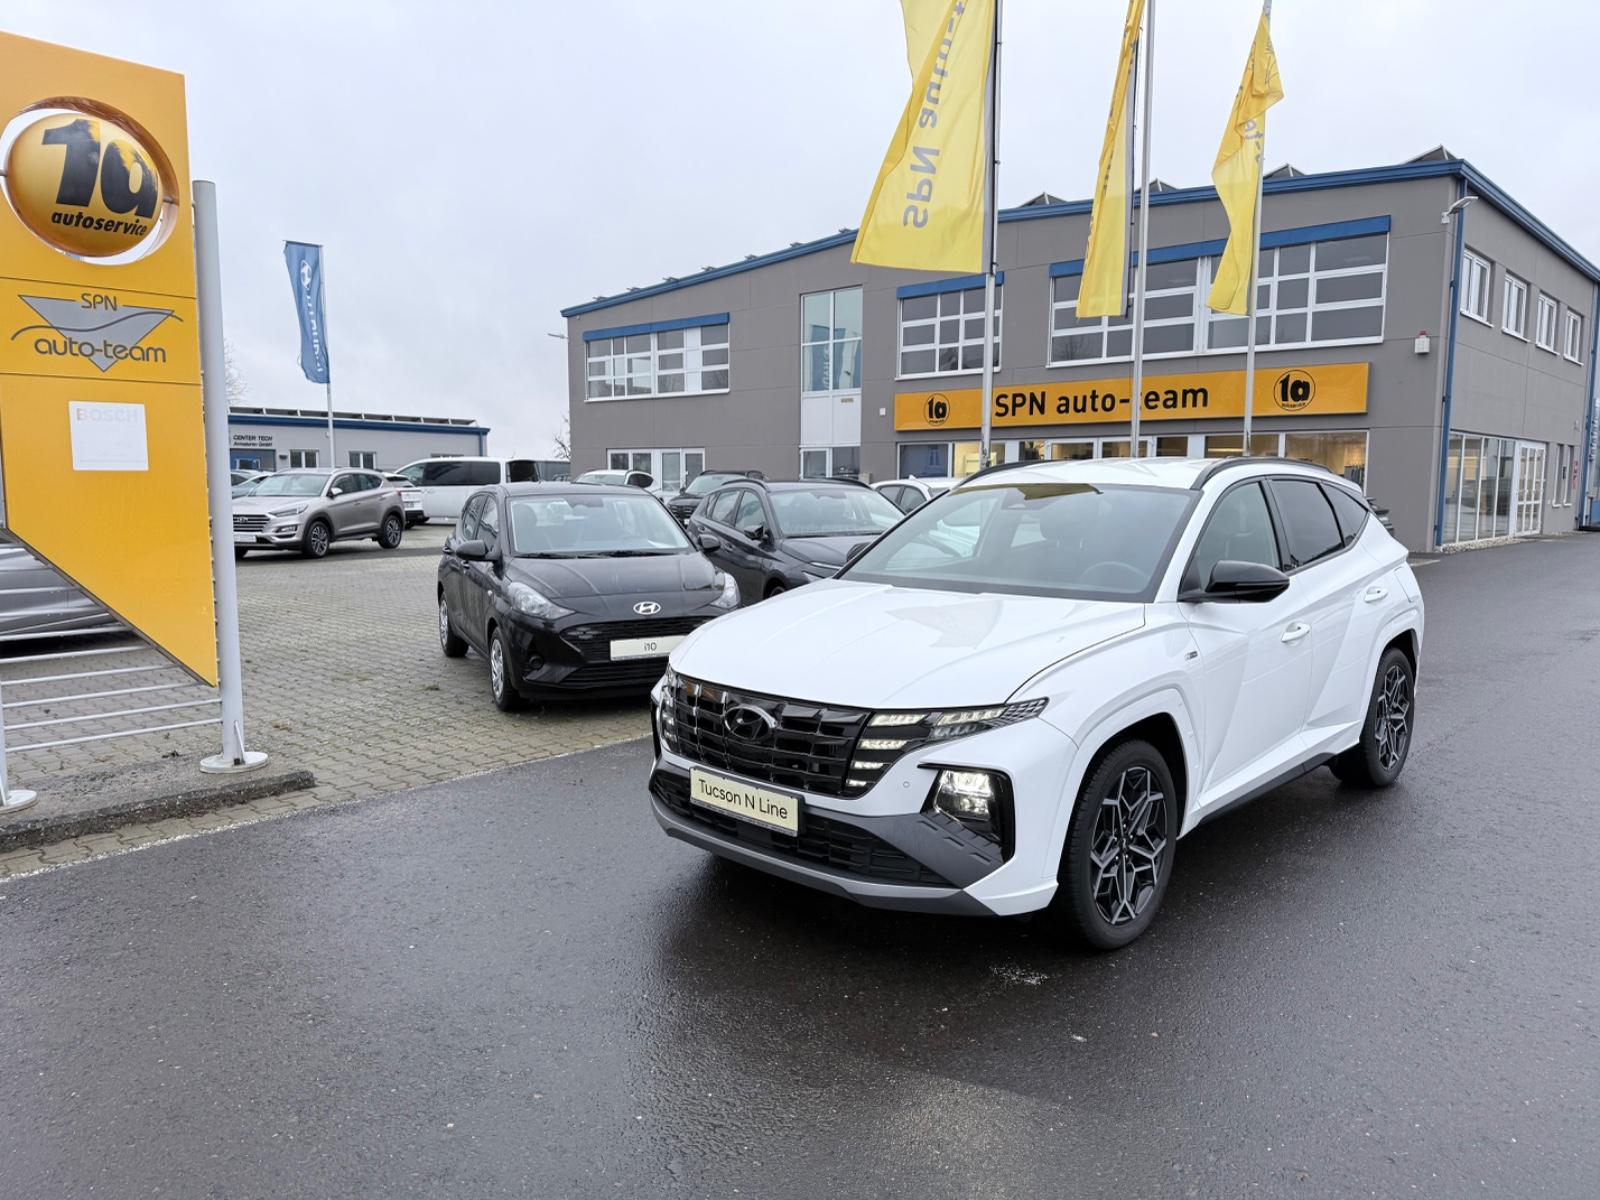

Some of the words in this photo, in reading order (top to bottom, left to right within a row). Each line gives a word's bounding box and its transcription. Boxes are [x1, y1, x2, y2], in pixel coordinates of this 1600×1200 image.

[42, 119, 158, 219] 1a
[51, 211, 148, 237] autoservice
[81, 293, 117, 311] SPN
[34, 336, 167, 363] auto-team
[1279, 373, 1311, 402] 1a
[76, 407, 138, 422] BOSCH
[928, 396, 948, 419] 1a
[995, 391, 1047, 417] SPN
[1055, 387, 1209, 414] auto-eam
[643, 641, 657, 651] i10
[698, 778, 742, 806] Tucson
[744, 793, 755, 810] N
[759, 797, 788, 820] Line
